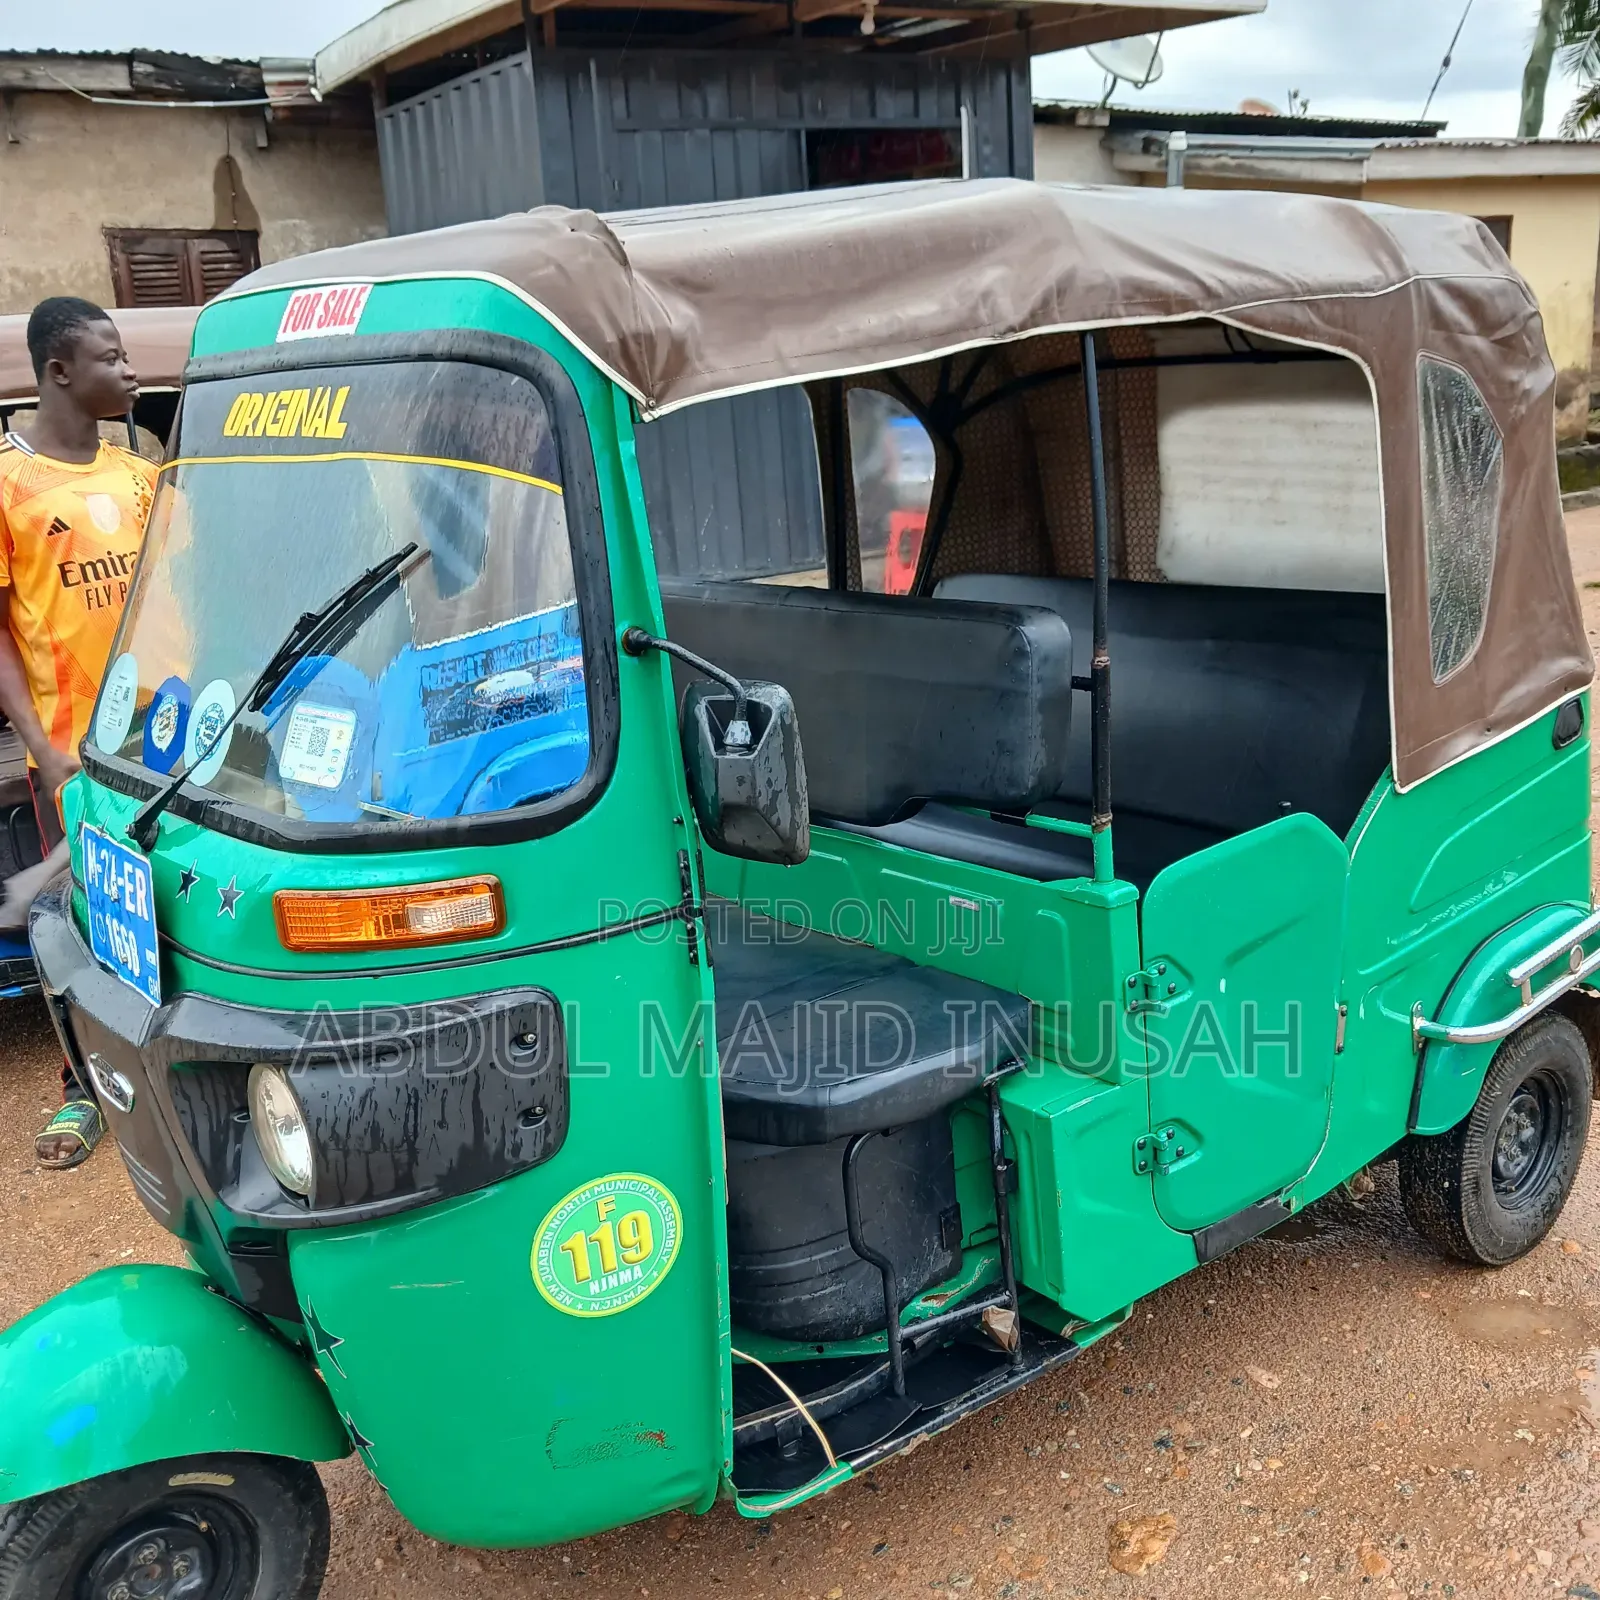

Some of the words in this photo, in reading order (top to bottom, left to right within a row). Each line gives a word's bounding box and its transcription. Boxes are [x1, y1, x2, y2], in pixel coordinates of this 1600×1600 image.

[282, 291, 323, 334] FOR
[316, 286, 369, 329] SALE
[223, 386, 351, 439] ORIGINAL
[85, 584, 112, 610] FLY
[549, 1190, 592, 1229] NORTH
[594, 1180, 660, 1201] MUNICIPAL
[596, 1194, 617, 1222] F
[559, 1209, 654, 1285] 119
[658, 1198, 677, 1263] ASSEMBLY
[538, 1230, 554, 1283] JUABEN
[547, 1283, 574, 1306] NEW
[589, 1264, 643, 1296] NJNMA
